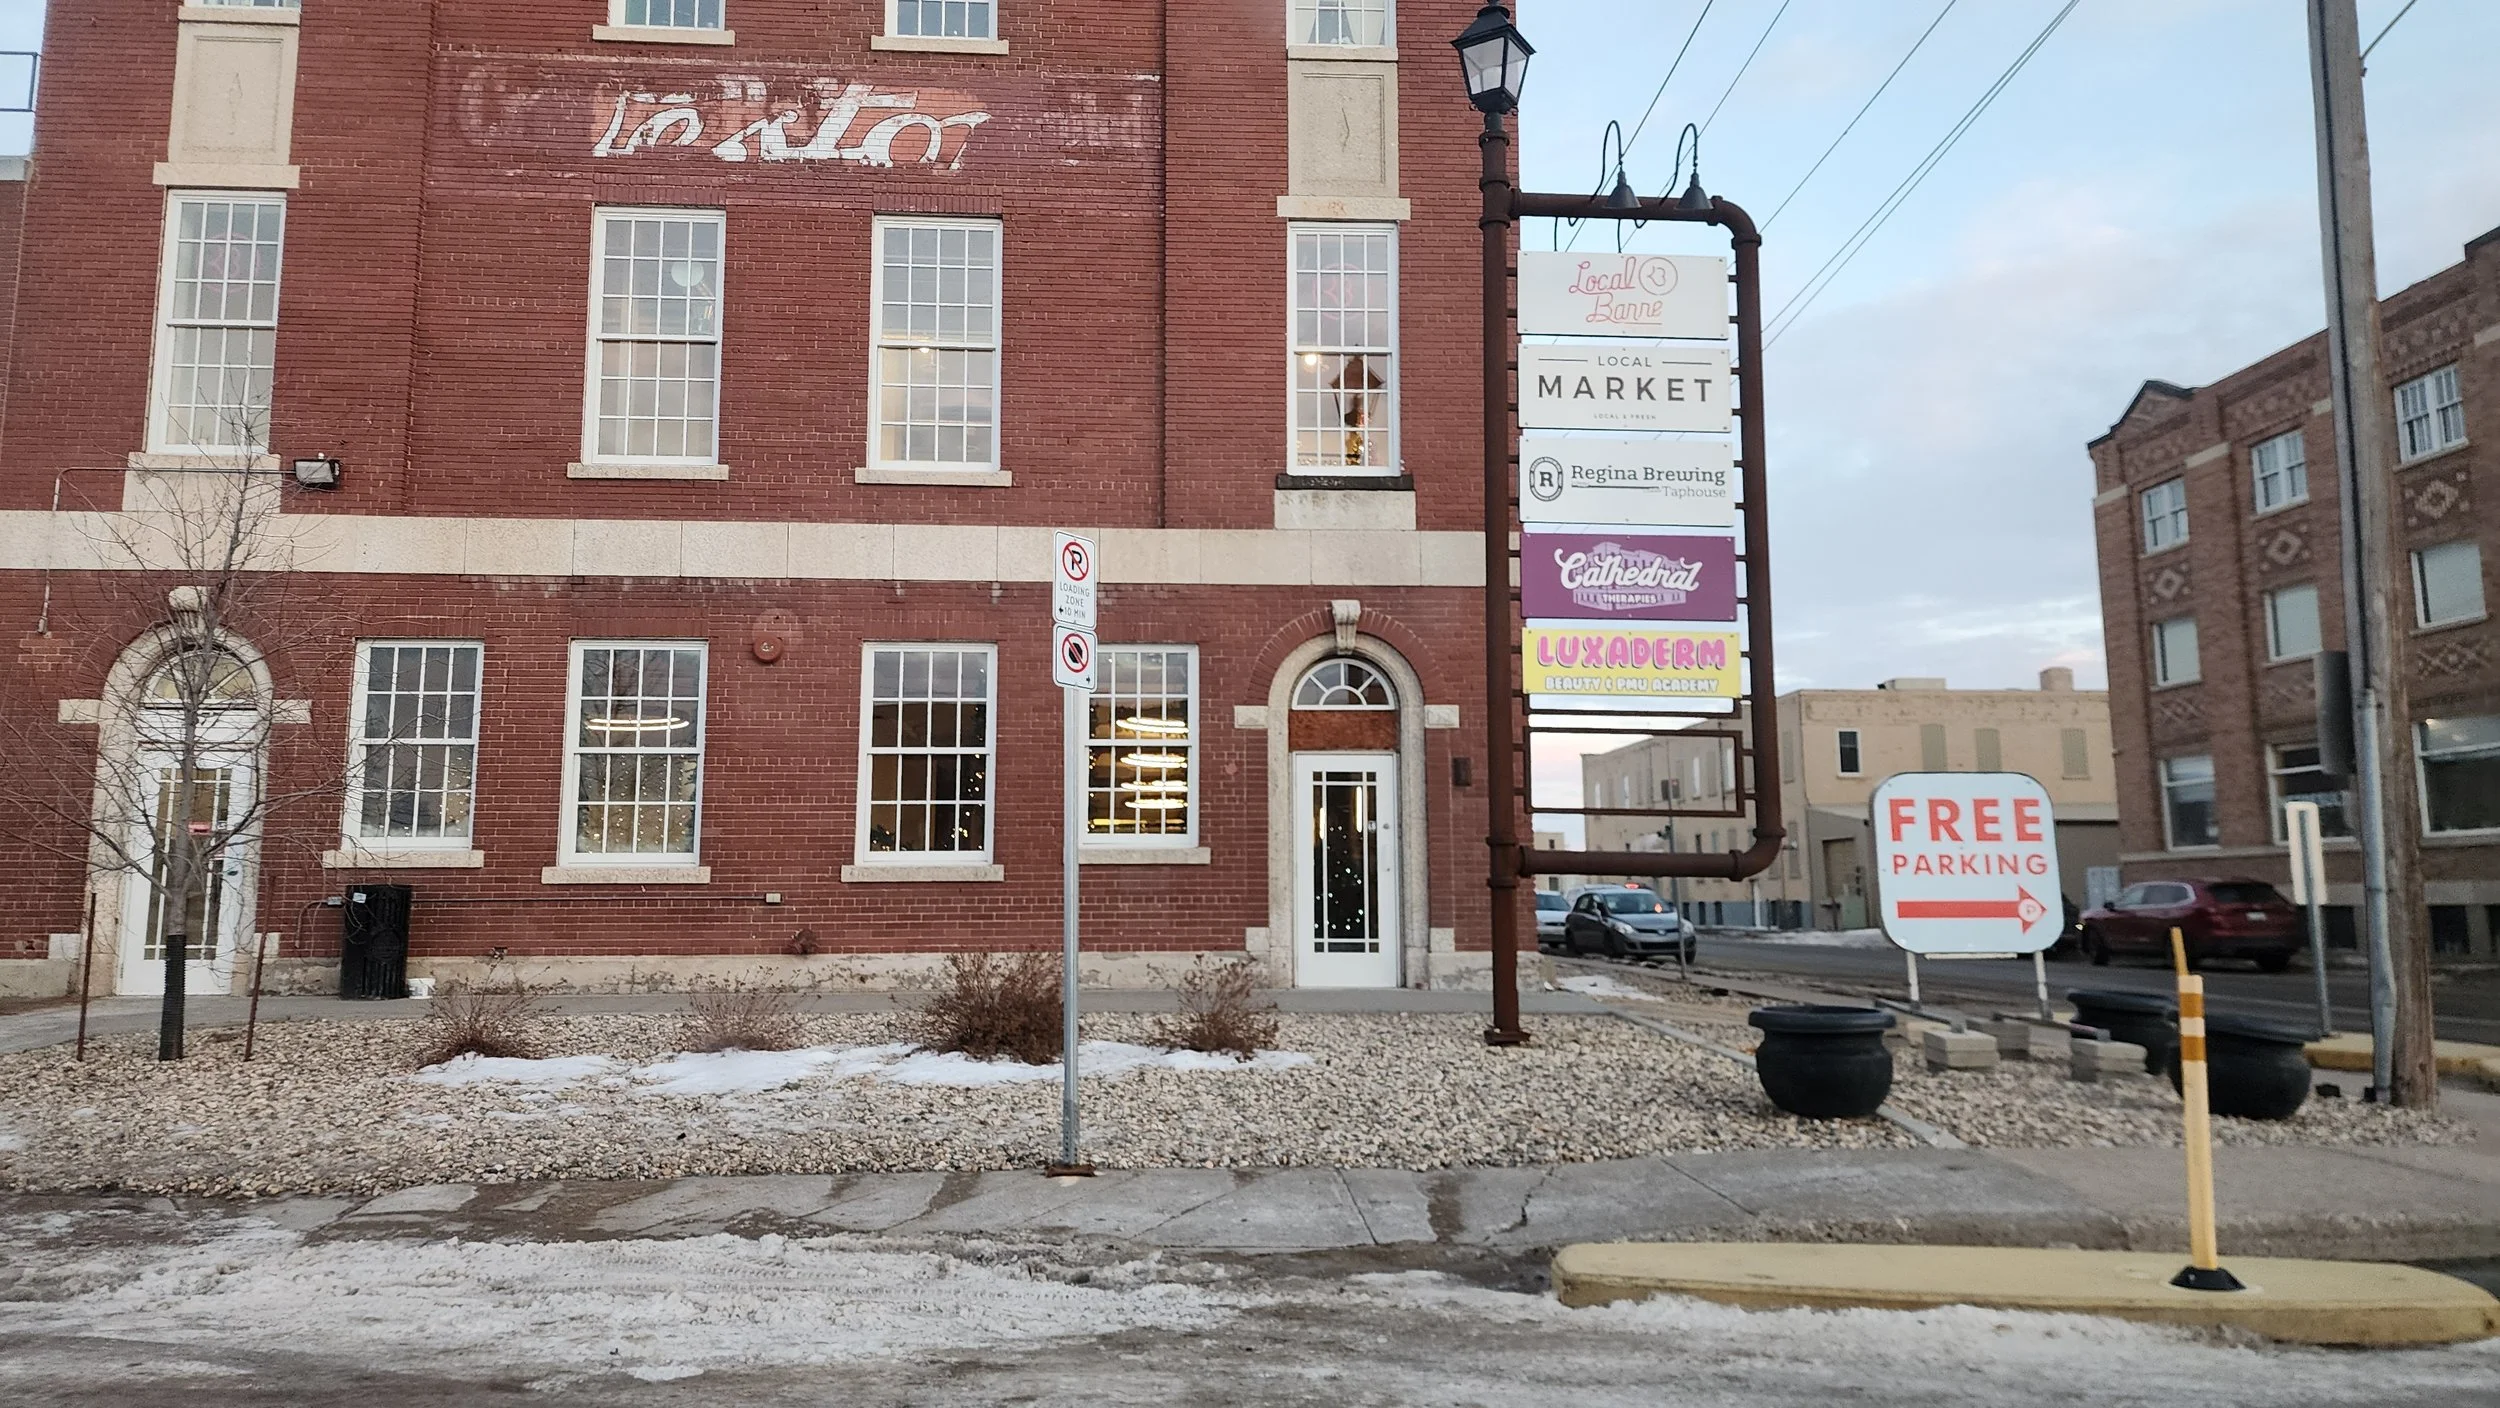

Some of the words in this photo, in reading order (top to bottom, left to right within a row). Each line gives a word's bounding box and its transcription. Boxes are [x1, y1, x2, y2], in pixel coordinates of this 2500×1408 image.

[1568, 256, 1636, 294] Local
[1597, 356, 1652, 368] LOCAL
[1538, 374, 1712, 402] MARKET
[1571, 465, 1638, 484] Regina
[1643, 466, 1726, 486] Brewing
[1661, 486, 1727, 499] Taphouse
[1554, 548, 1703, 591] Cathedral
[1059, 581, 1090, 598] LOADING
[1602, 593, 1657, 604] THERAPIES
[1065, 594, 1085, 608] ZONE
[1064, 606, 1072, 616] 10
[1073, 607, 1086, 619] MIN
[1537, 635, 1727, 670] LUXADERM
[1545, 676, 1601, 691] BEAUTY
[1616, 677, 1649, 691] PMU
[1652, 678, 1719, 692] ACADEMY
[1888, 798, 2044, 842] FREE
[1892, 854, 2049, 875] PARKING
